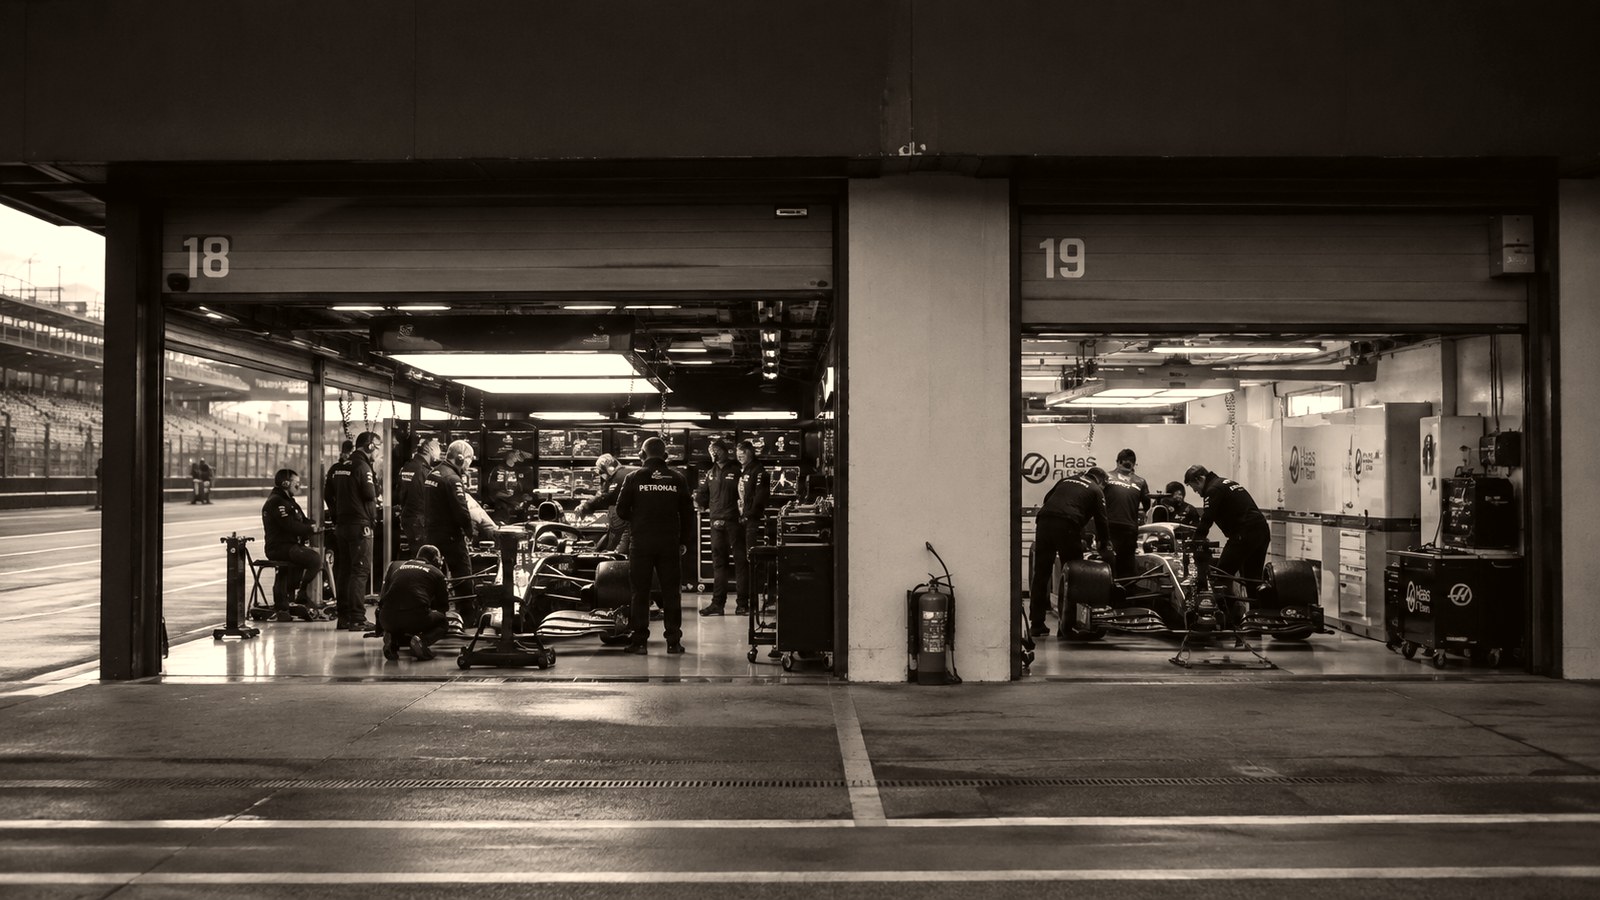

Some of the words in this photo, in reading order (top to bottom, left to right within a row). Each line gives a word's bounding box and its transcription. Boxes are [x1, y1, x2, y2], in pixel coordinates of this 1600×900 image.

[183, 236, 229, 278] 18
[1039, 238, 1085, 278] 19
[1053, 454, 1097, 468] Haas
